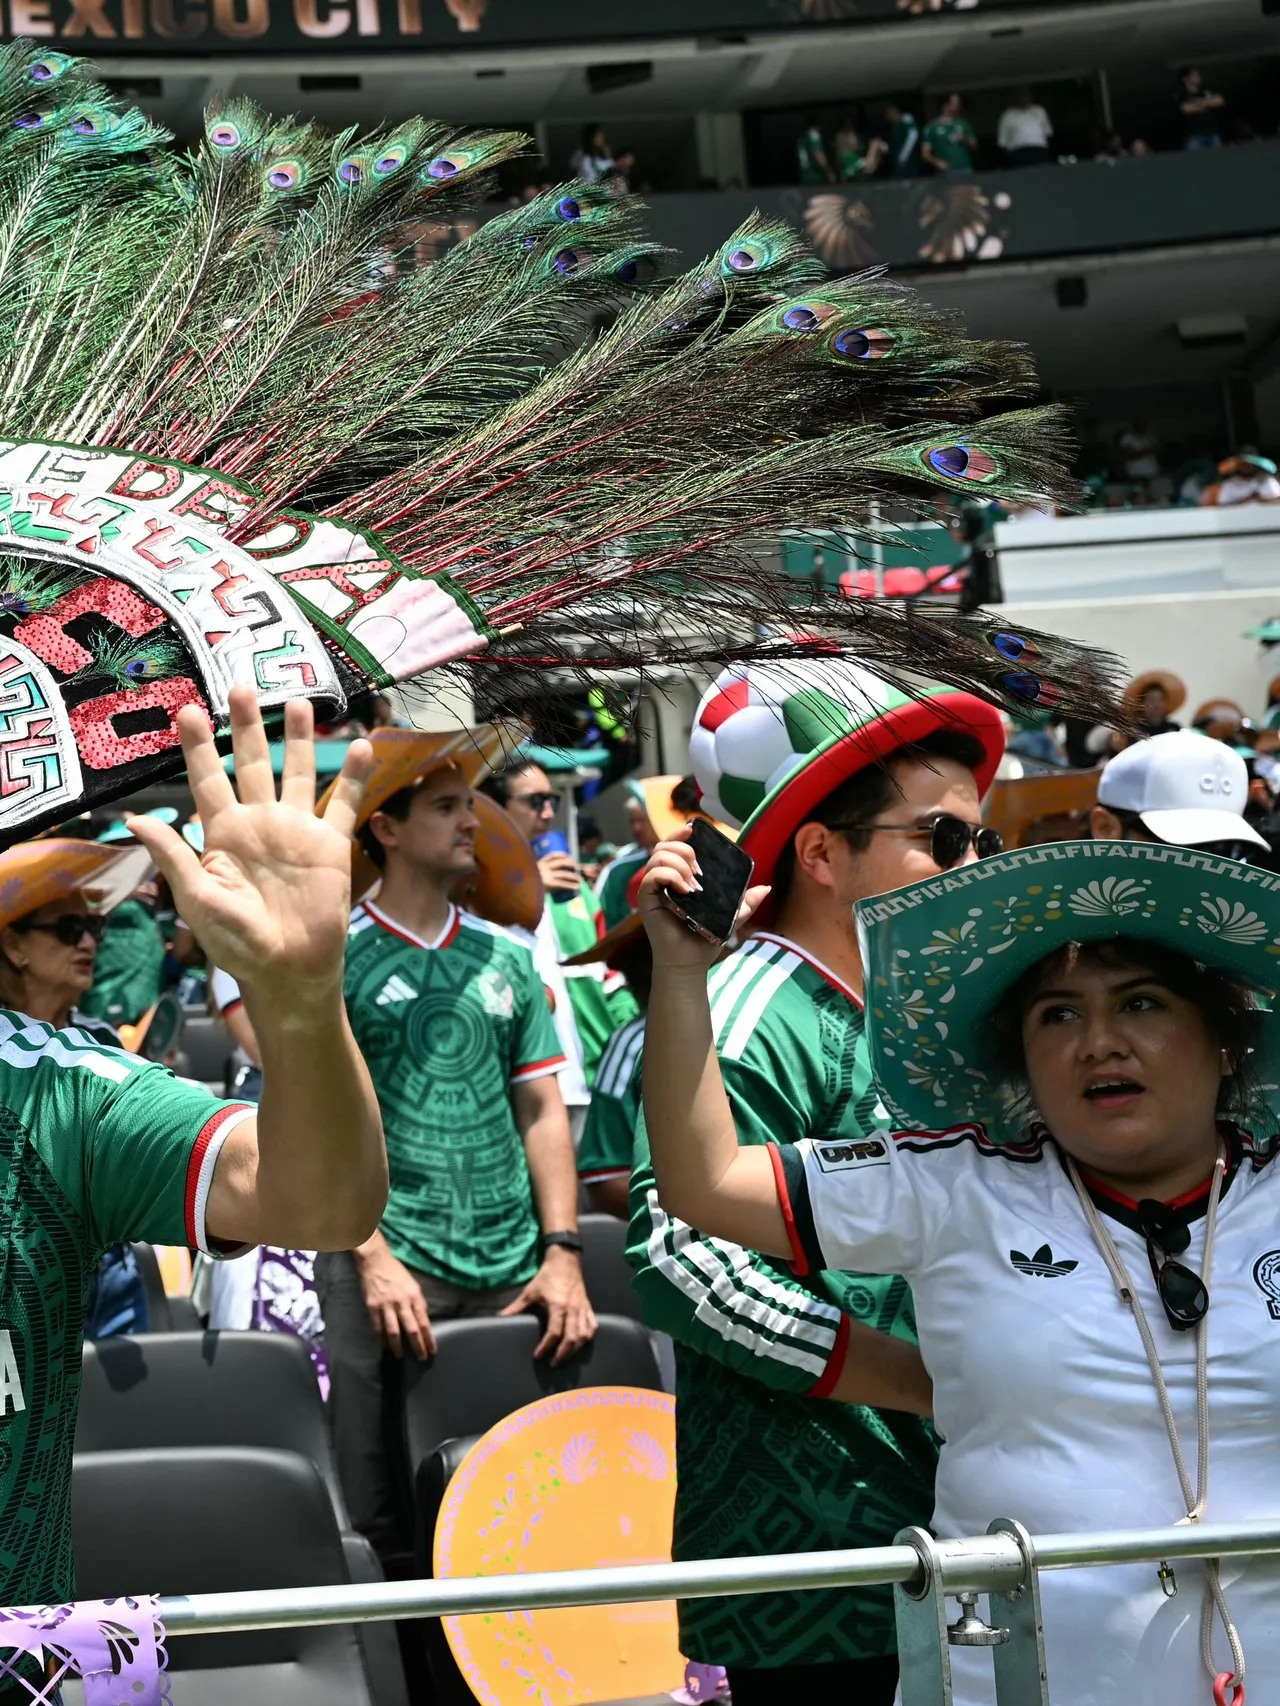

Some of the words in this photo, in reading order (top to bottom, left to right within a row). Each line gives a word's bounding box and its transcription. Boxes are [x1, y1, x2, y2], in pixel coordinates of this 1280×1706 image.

[1065, 844, 1128, 858] FIFA
[906, 877, 965, 905] FIFA
[1243, 870, 1280, 891] FI
